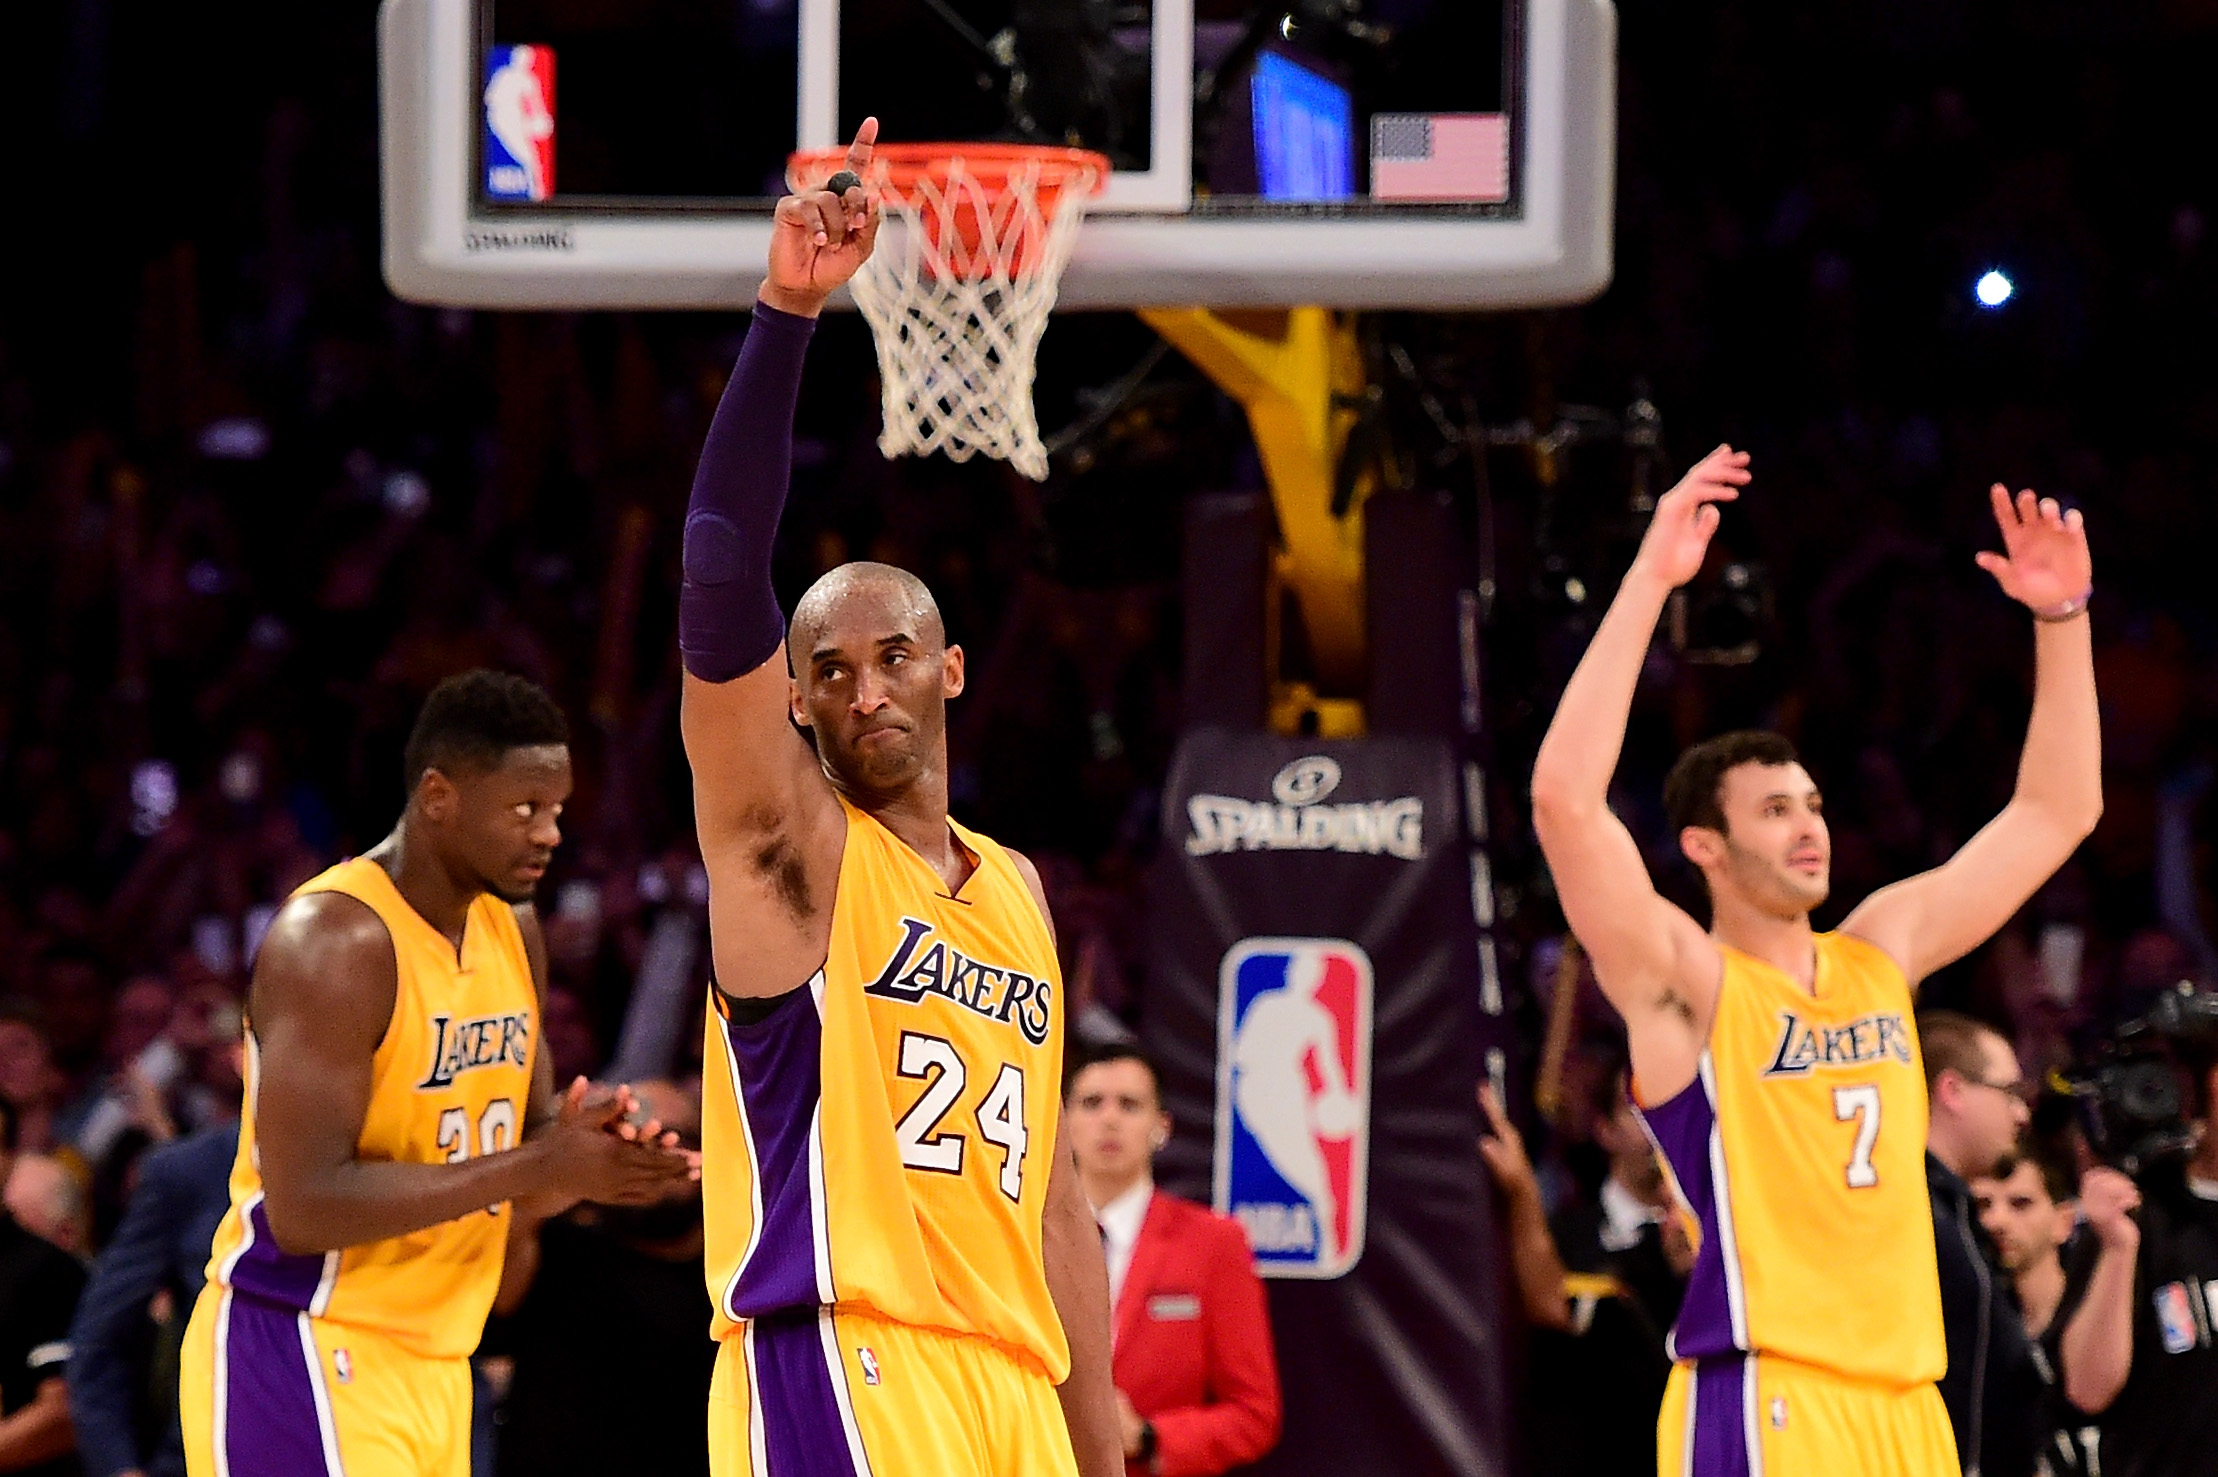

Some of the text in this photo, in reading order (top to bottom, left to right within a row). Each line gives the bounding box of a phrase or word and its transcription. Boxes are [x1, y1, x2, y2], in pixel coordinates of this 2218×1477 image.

[1186, 794, 1424, 860] SPALDING
[862, 917, 1051, 1046] LAKERS
[895, 1029, 1028, 1204] 24
[1832, 1085, 1881, 1188] 7
